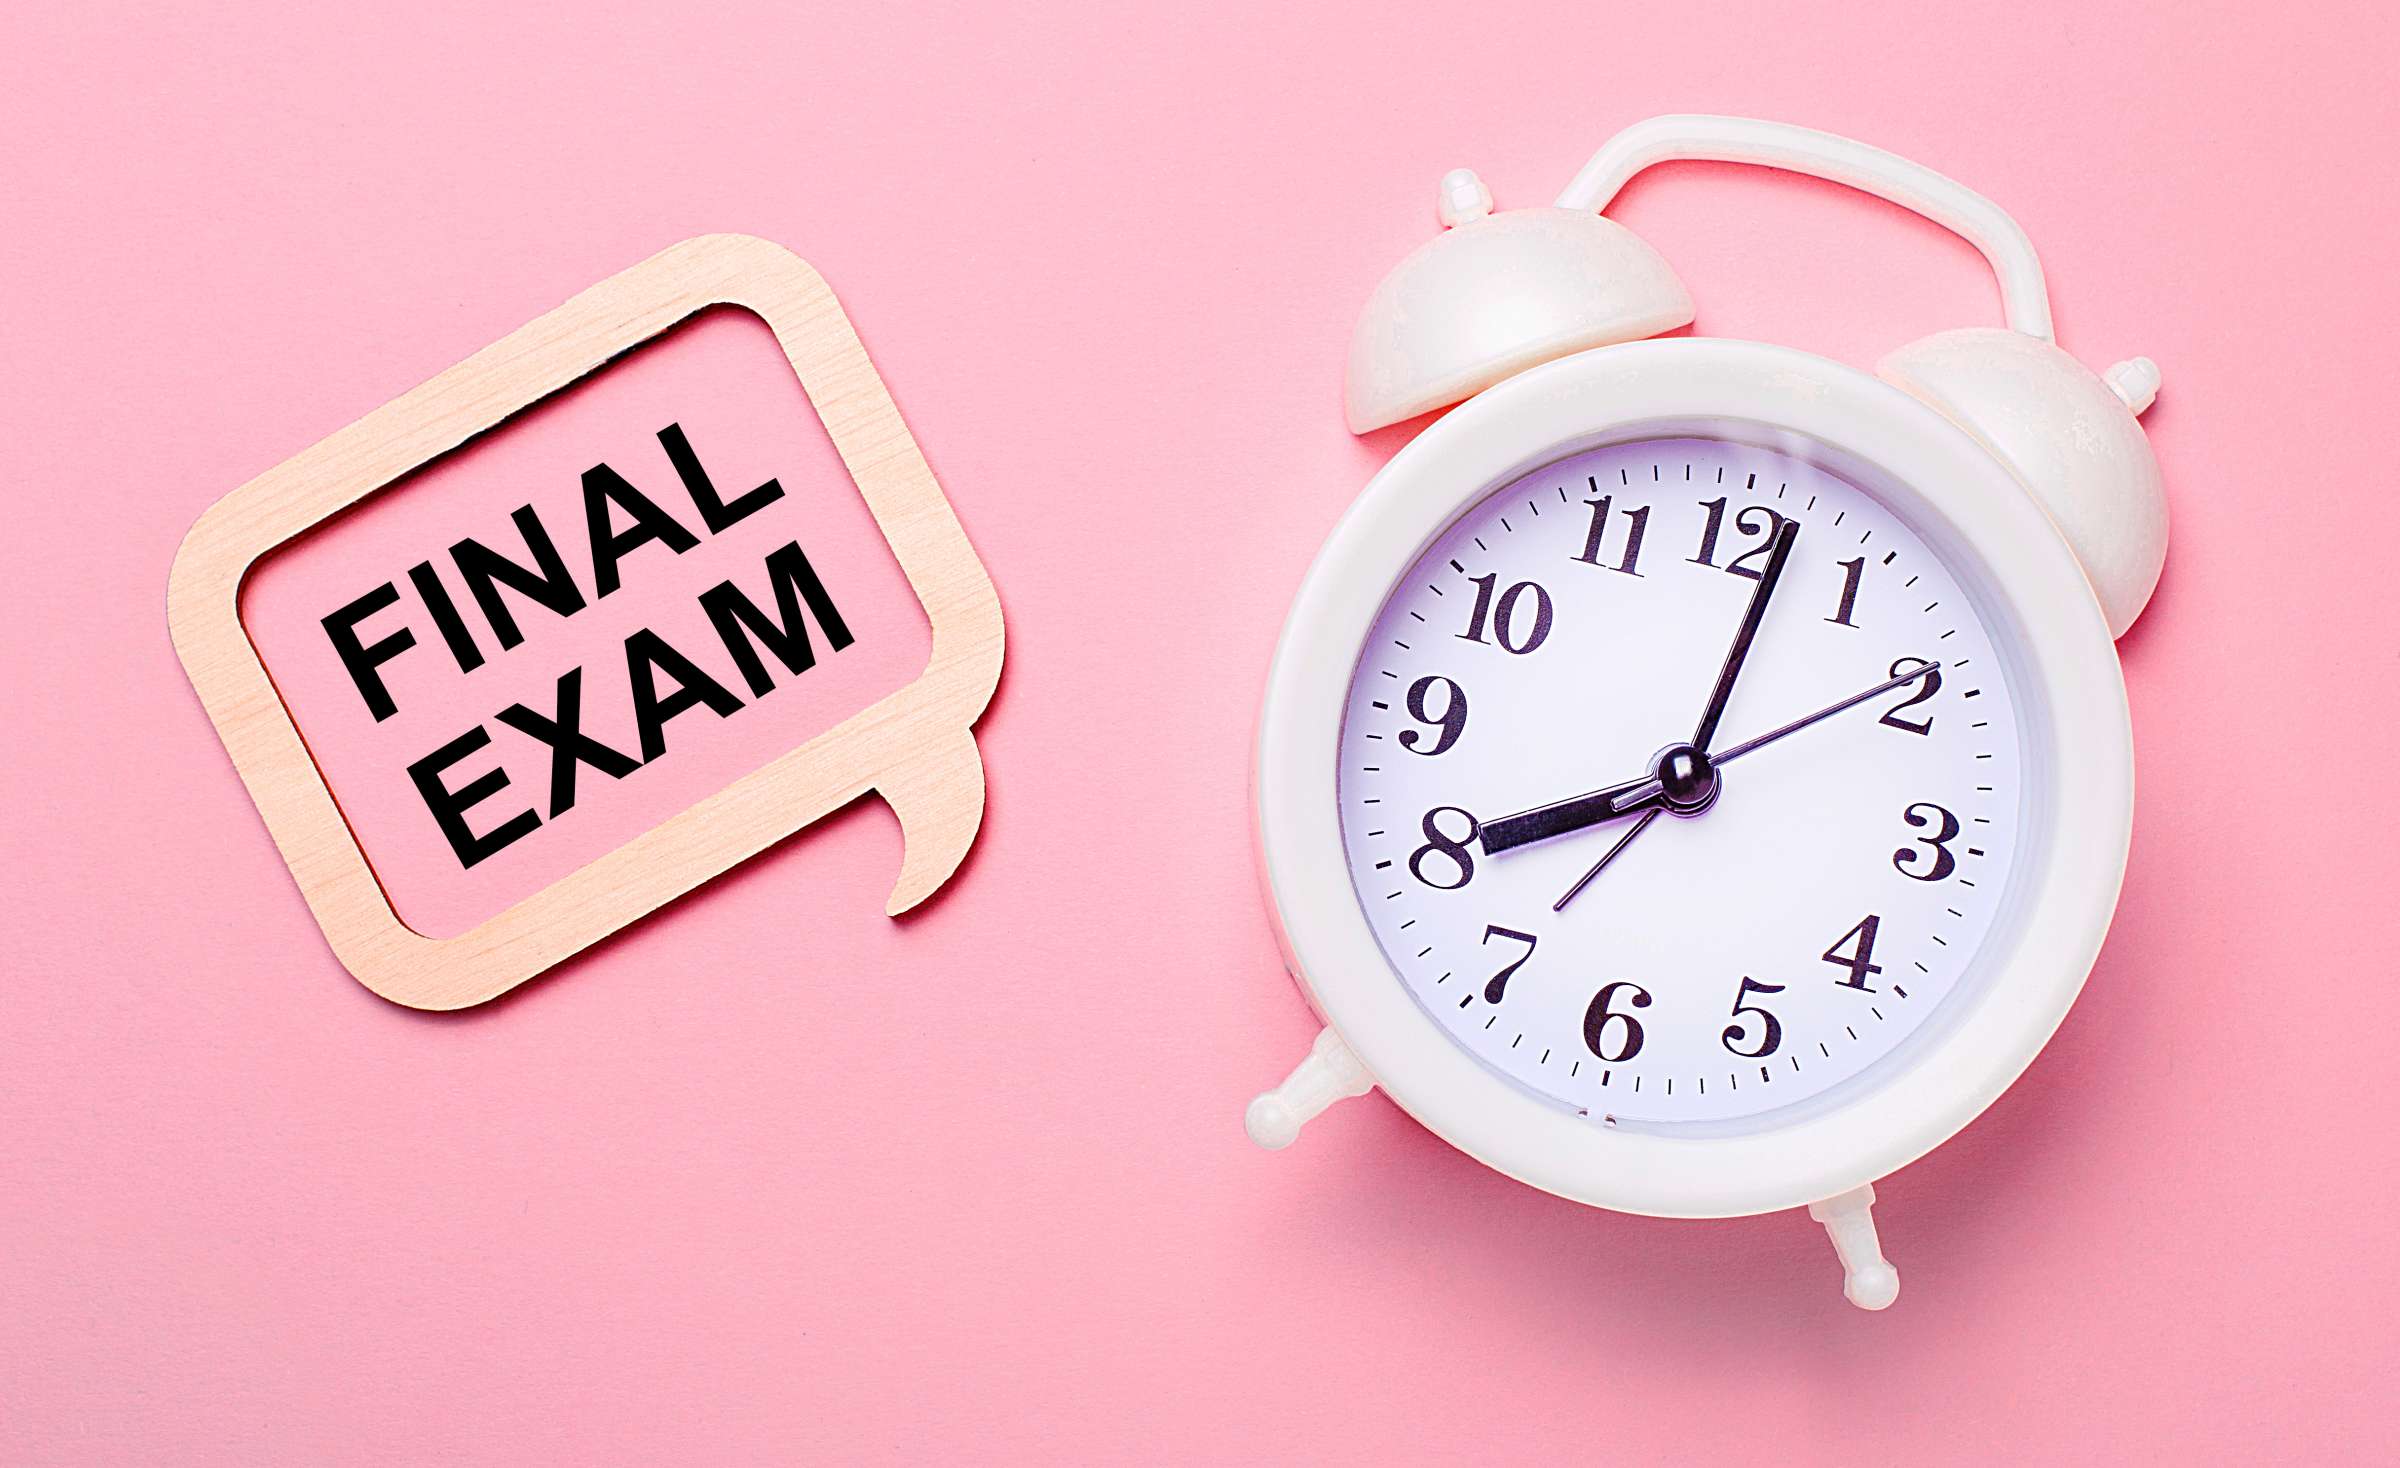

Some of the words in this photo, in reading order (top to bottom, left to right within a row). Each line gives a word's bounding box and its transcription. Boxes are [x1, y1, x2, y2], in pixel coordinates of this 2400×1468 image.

[320, 422, 786, 724] FINAL
[1571, 495, 1651, 578] 11
[1685, 496, 1783, 581] 12
[1455, 572, 1554, 655] 10
[1823, 556, 1865, 629] 1
[406, 540, 856, 871] EXAM
[1398, 675, 1468, 756] 9
[1878, 656, 1942, 736] 2
[1408, 806, 1479, 890] 8
[1892, 802, 1960, 882] 3
[1482, 924, 1537, 1005] 7
[1821, 914, 1882, 994] 4
[1583, 981, 1653, 1063] 6
[1721, 976, 1786, 1058] 5
